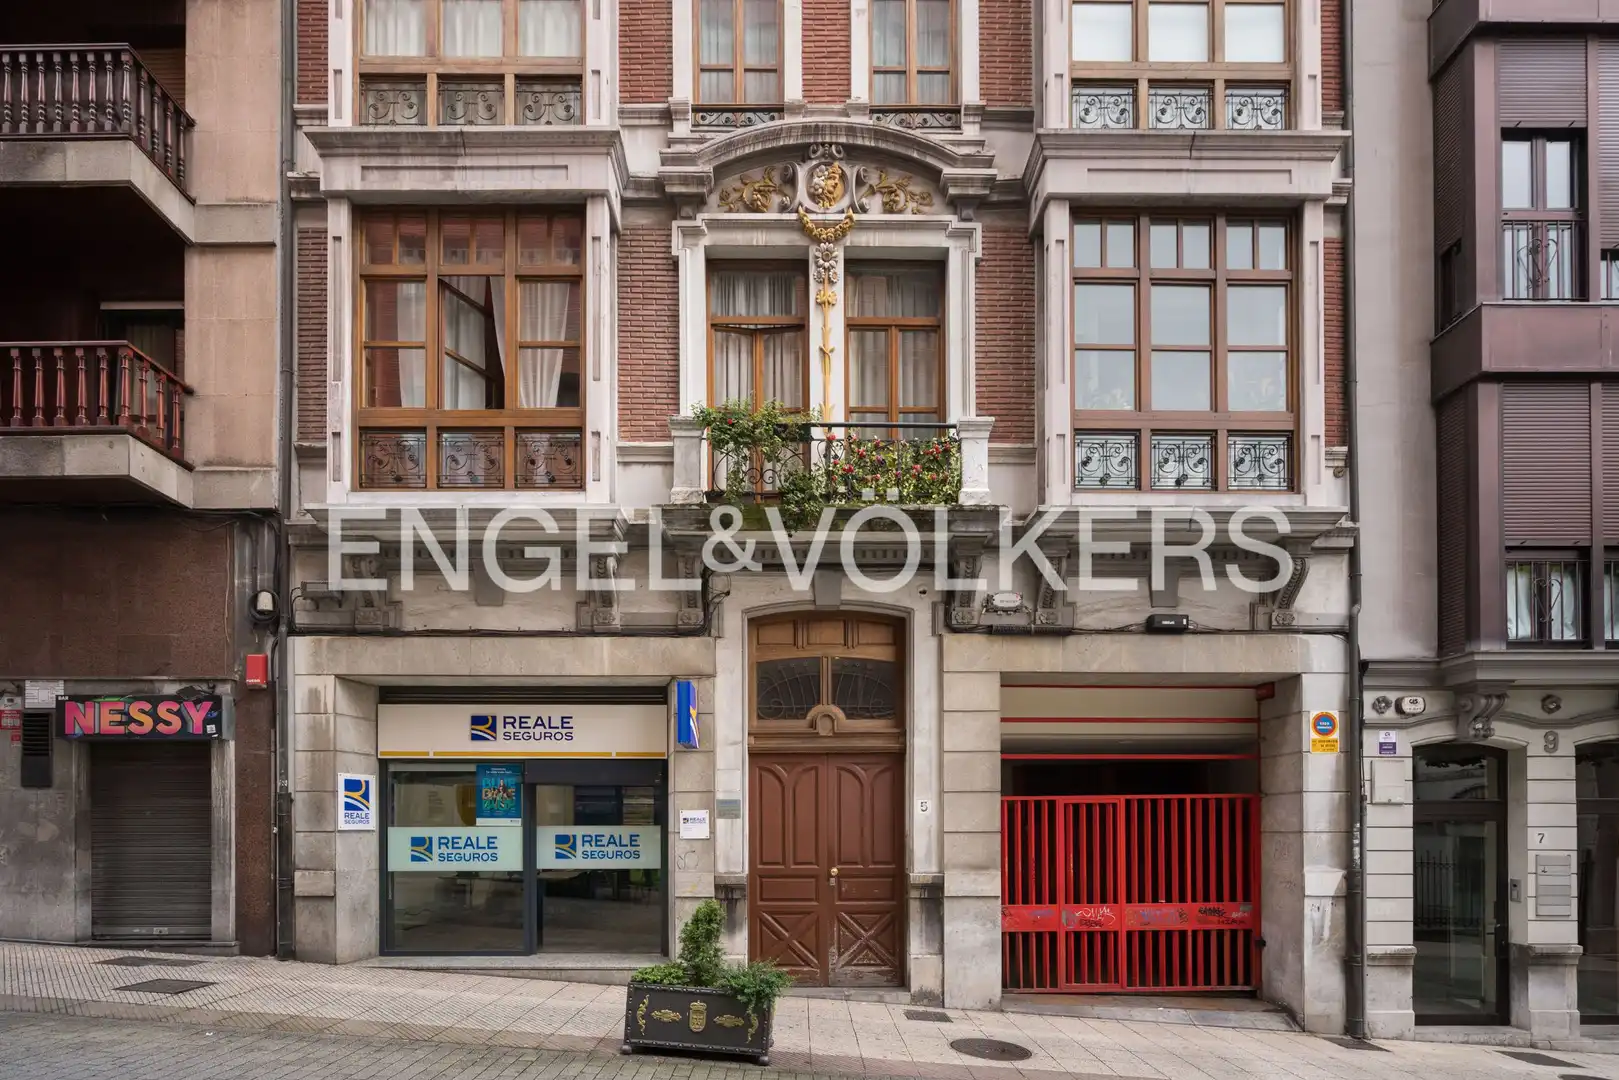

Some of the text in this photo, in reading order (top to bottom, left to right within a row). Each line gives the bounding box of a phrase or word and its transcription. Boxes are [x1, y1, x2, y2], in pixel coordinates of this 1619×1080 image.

[65, 701, 213, 735] NESSY
[503, 715, 573, 729] REALE
[502, 732, 573, 741] SEGUROS
[1544, 731, 1558, 753] 9
[920, 801, 928, 812] 5
[344, 812, 370, 820] REALE
[437, 836, 498, 850] REALE
[581, 834, 641, 848] REALE
[1537, 833, 1545, 843] 7
[437, 852, 498, 862] SEGUROS
[581, 850, 641, 860] SEGUROS
